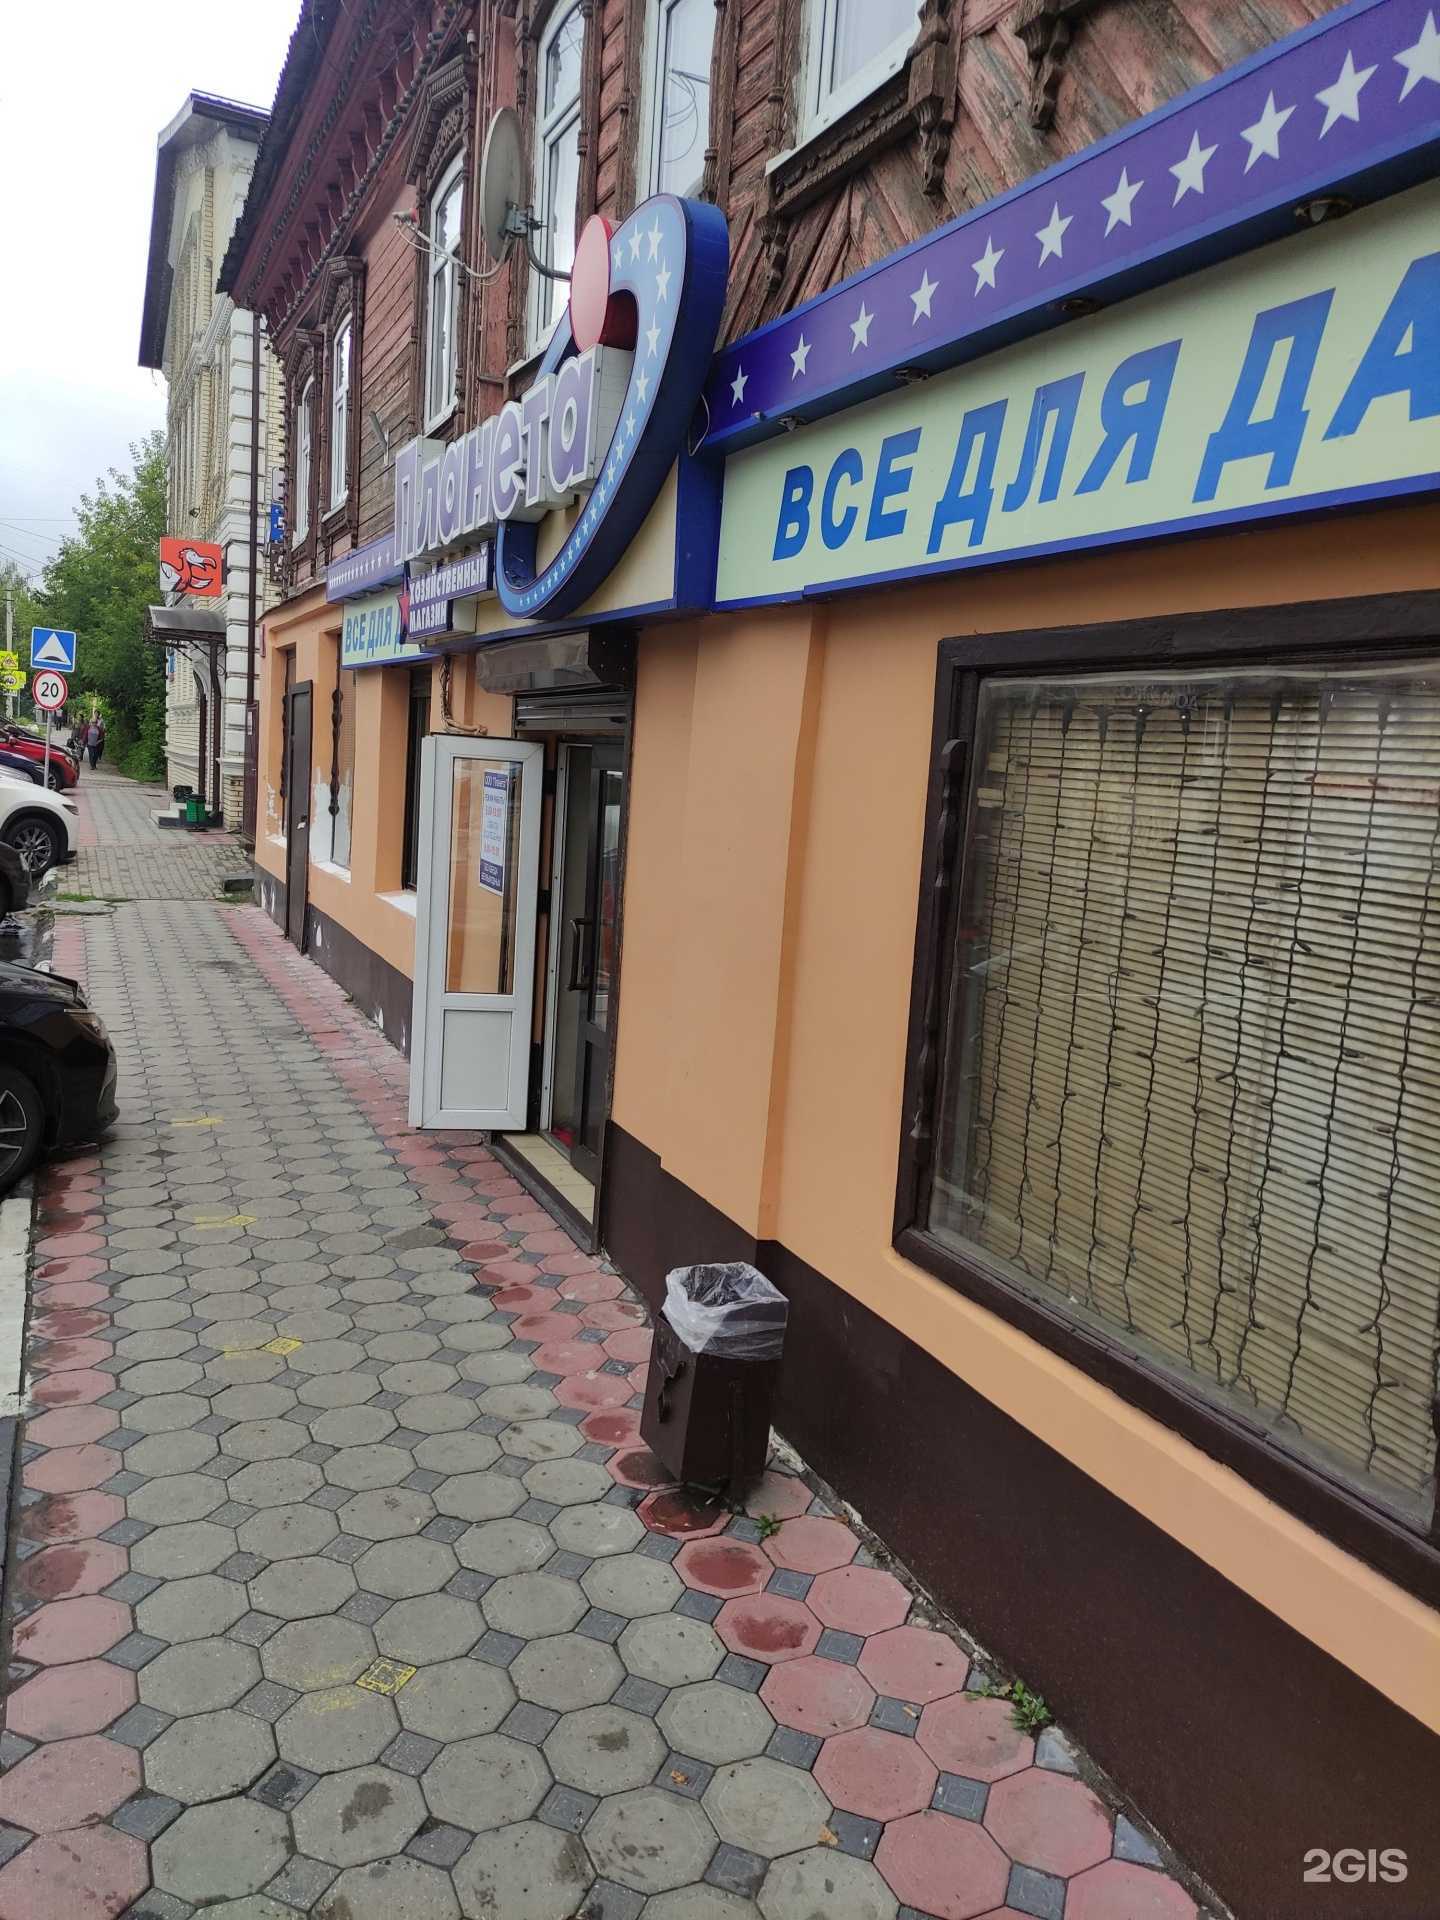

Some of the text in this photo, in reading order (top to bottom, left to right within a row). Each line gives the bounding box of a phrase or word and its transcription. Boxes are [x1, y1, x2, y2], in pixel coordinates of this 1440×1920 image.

[394, 345, 600, 566] Планета
[772, 426, 922, 561] ВСЕ
[926, 338, 1183, 555] ДЛЯ
[409, 546, 489, 606] ХОЗЯЙСТВЕННЫЙ
[345, 612, 366, 653] ВСЕ
[366, 606, 393, 658] ДЛЯ
[409, 600, 448, 633] МАГАЗИН
[41, 682, 59, 698] 20
